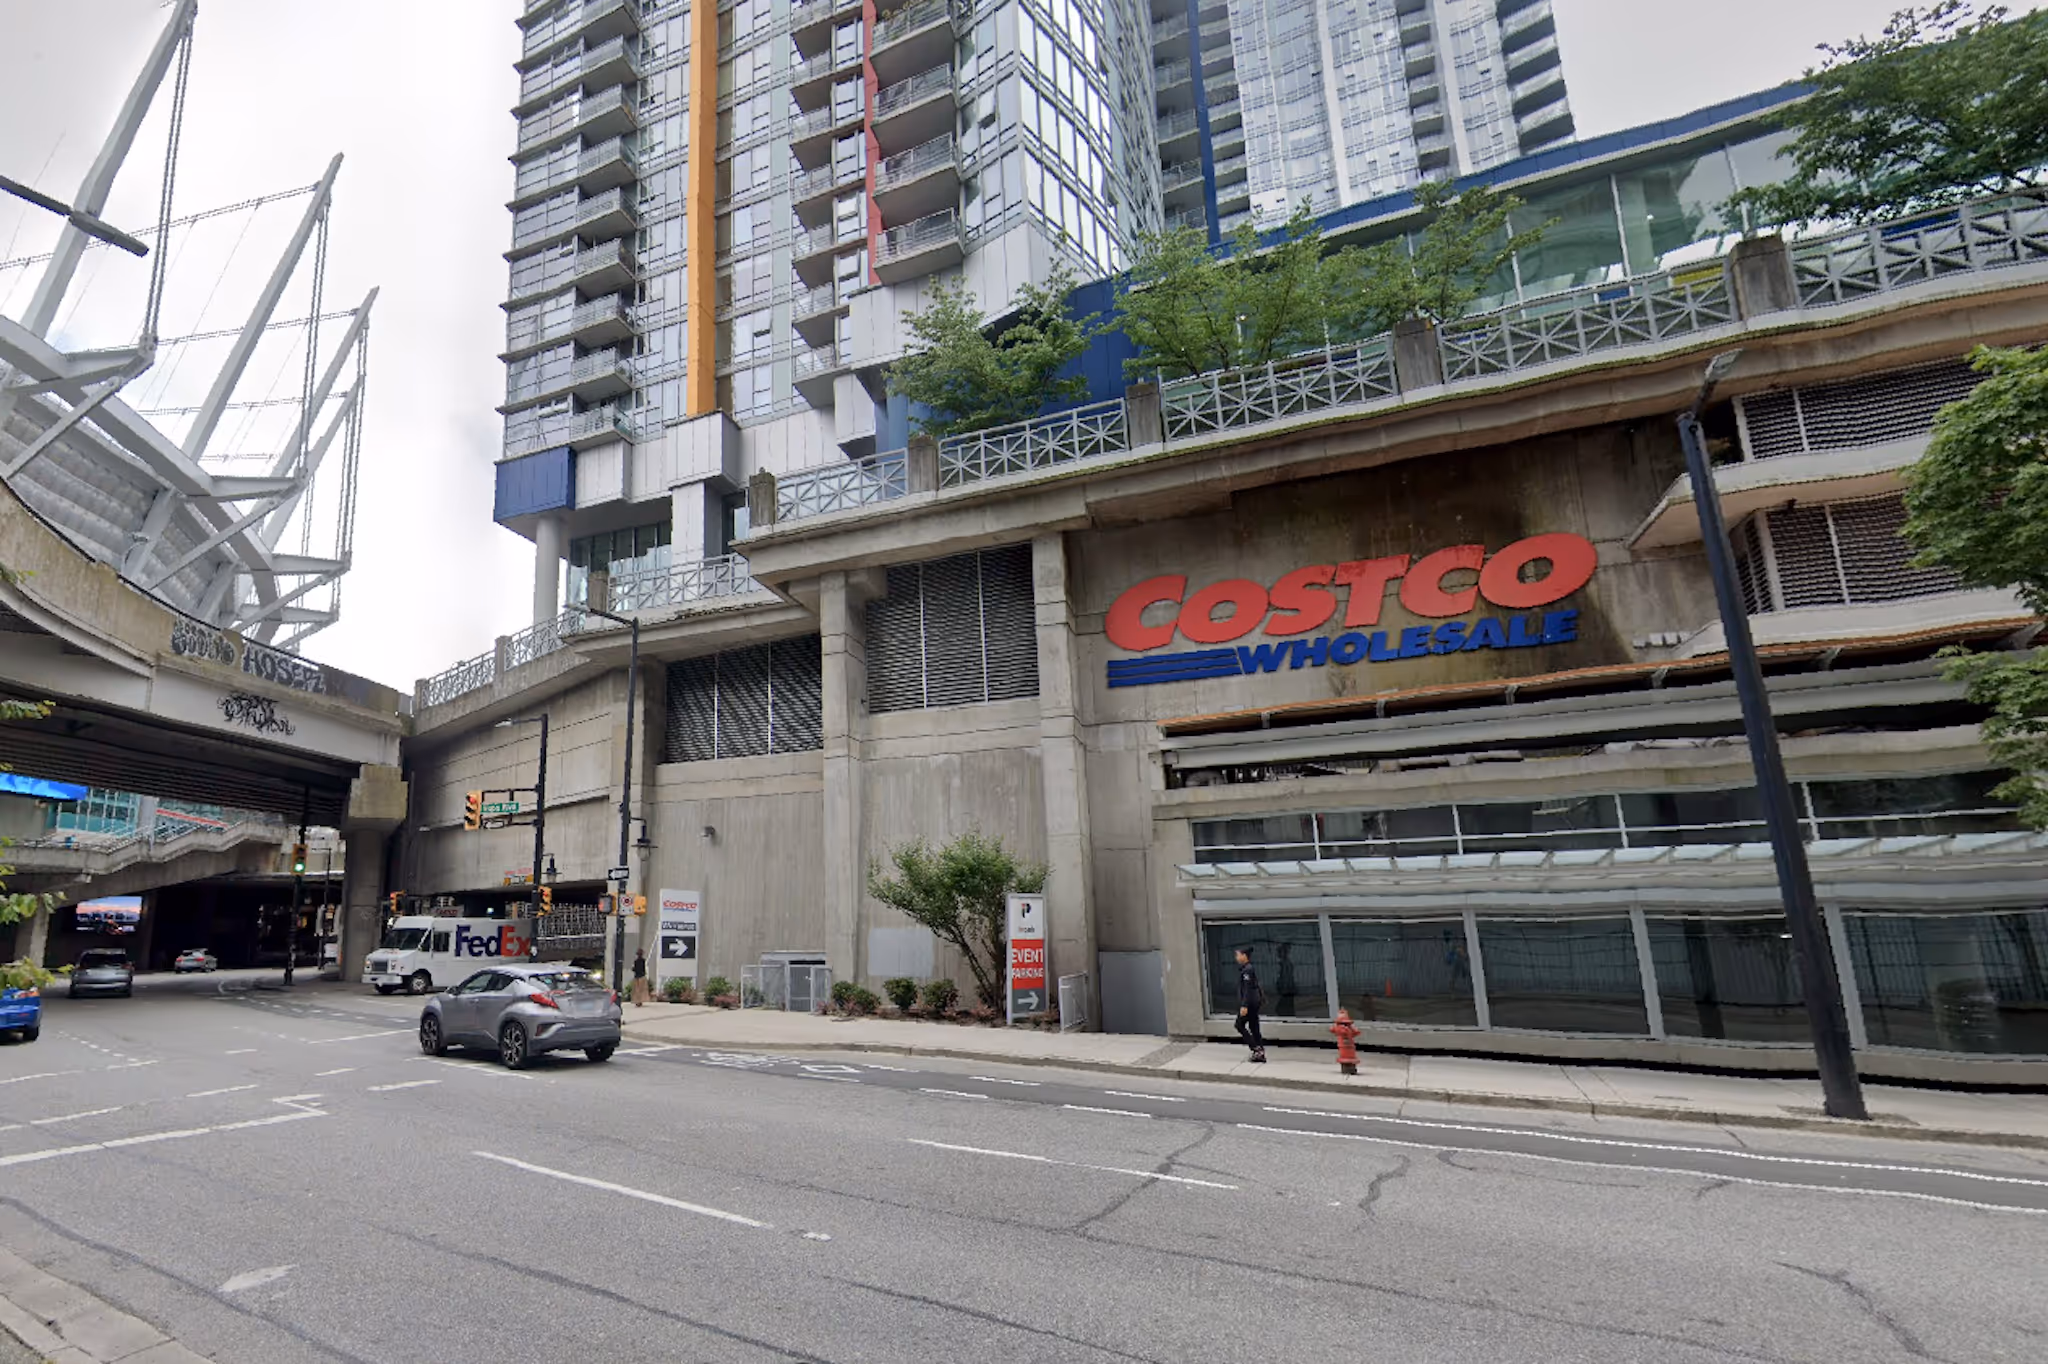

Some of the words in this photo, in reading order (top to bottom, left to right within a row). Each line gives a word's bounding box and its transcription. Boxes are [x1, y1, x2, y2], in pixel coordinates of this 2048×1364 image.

[1105, 533, 1597, 651] COSTCO
[1236, 609, 1578, 675] WHOLESALE
[456, 925, 531, 957] FedEx
[1012, 948, 1044, 963] EVENT
